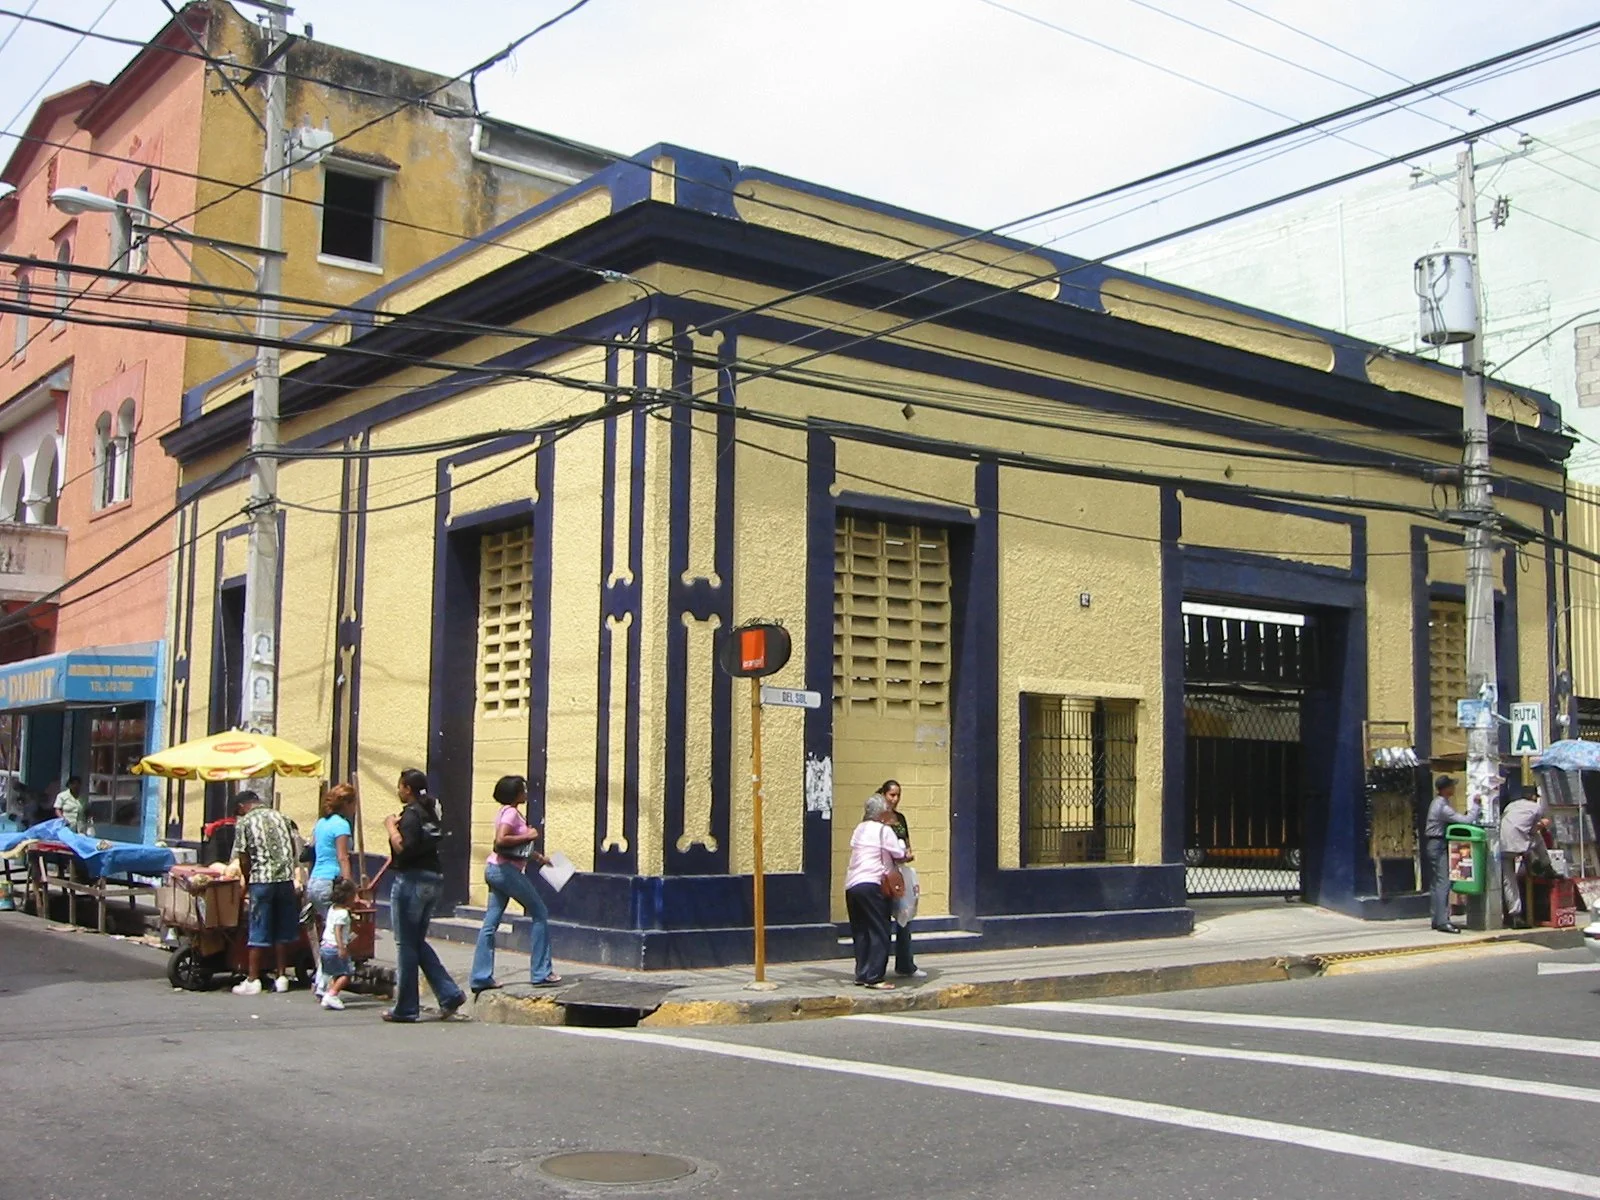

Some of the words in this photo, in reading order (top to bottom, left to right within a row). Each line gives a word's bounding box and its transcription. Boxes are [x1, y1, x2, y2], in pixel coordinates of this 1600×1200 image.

[9, 668, 55, 703] DUMIT
[782, 691, 793, 703] DEL
[795, 693, 807, 704] SOL
[1514, 708, 1537, 720] RUTA
[1516, 724, 1537, 750] A
